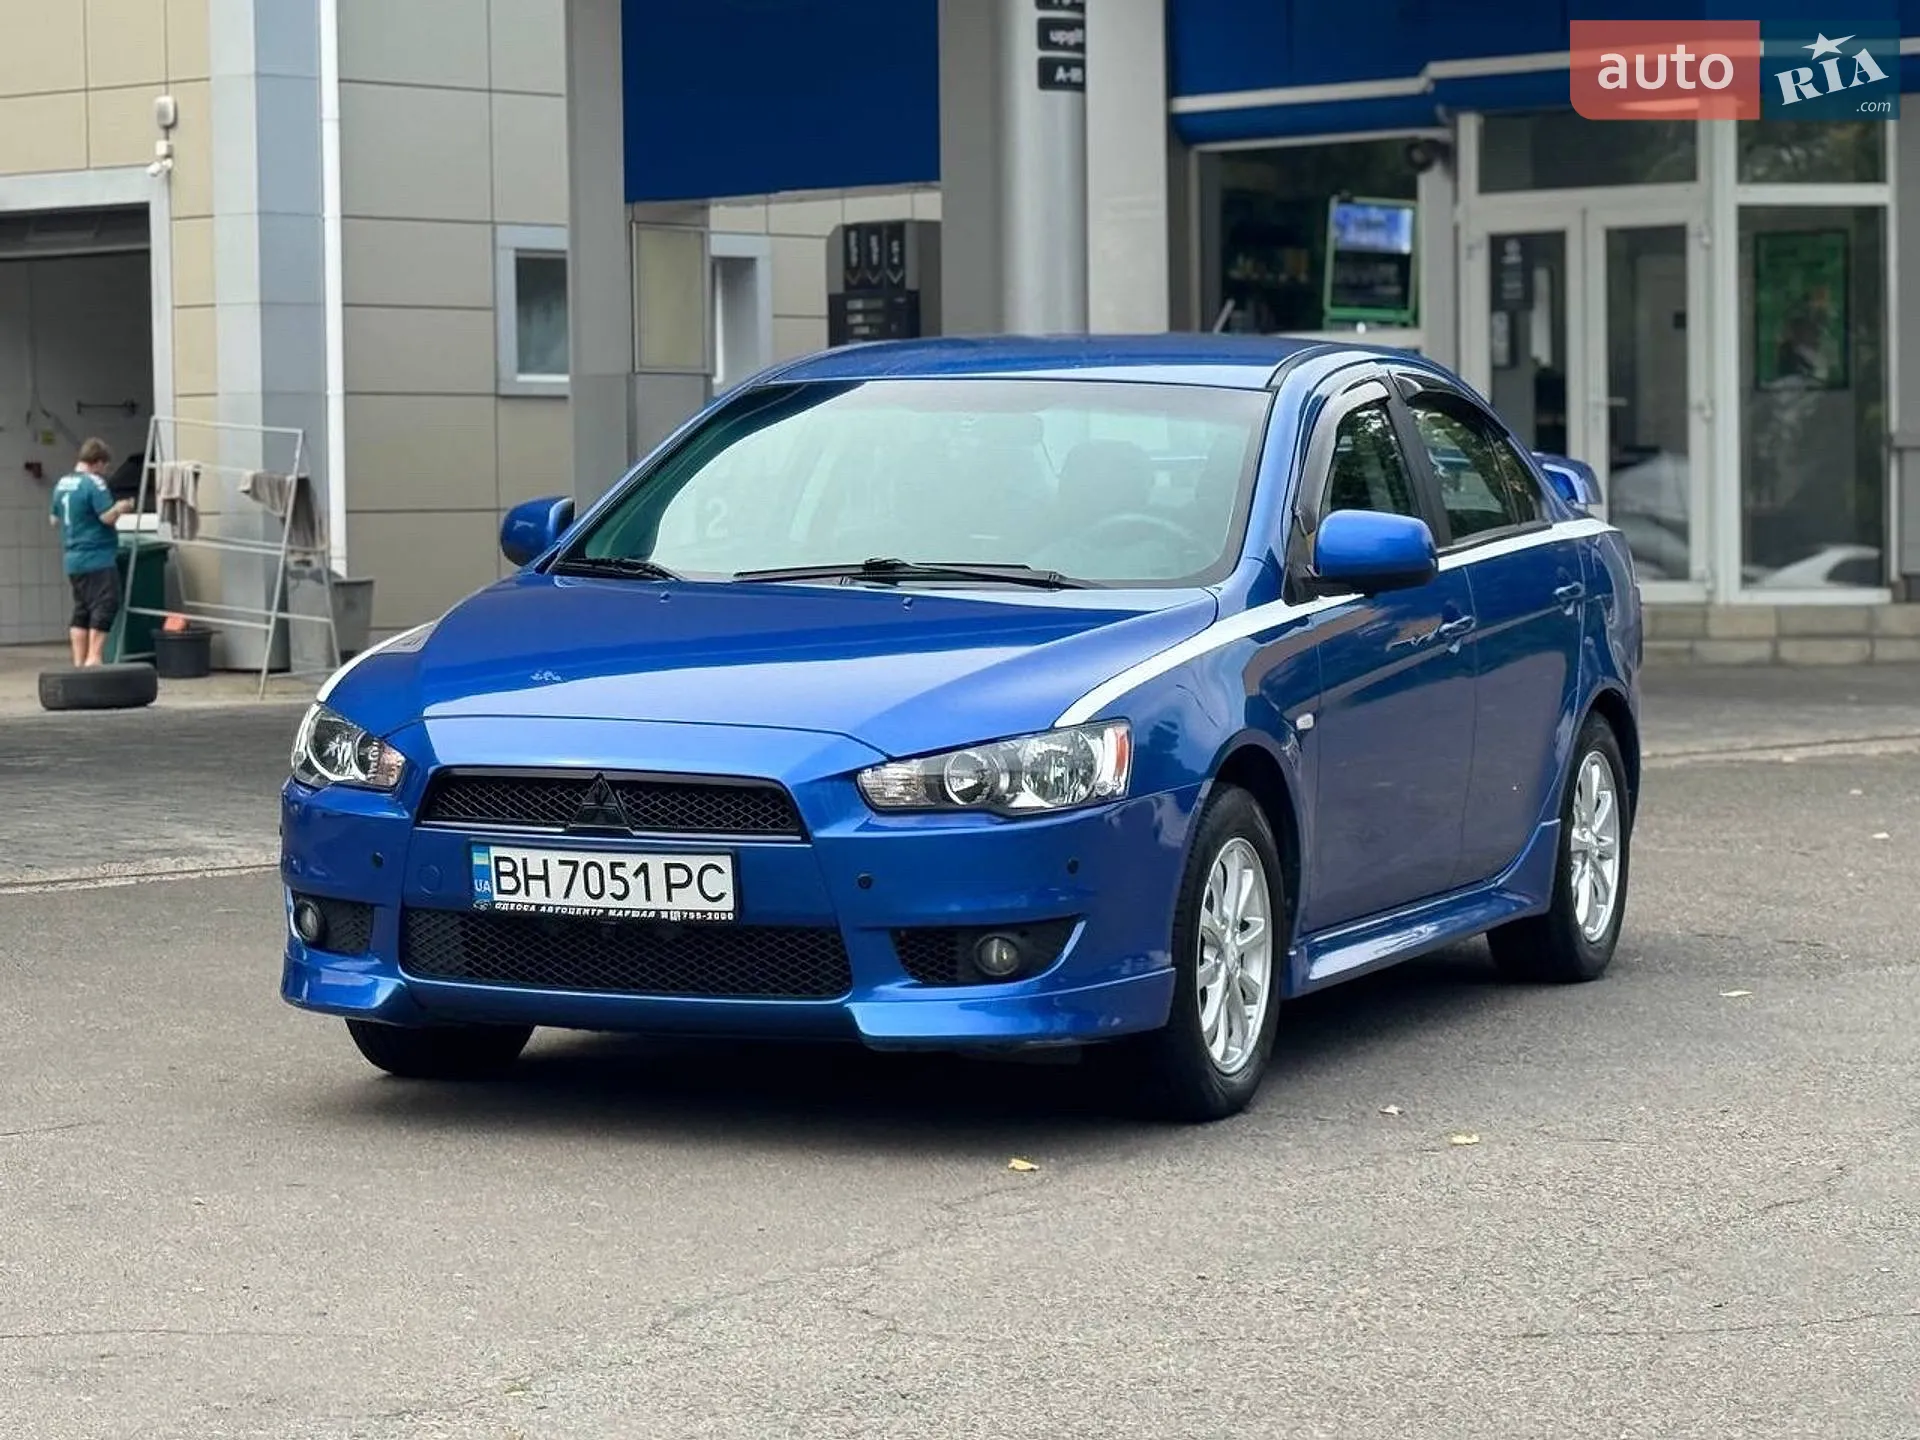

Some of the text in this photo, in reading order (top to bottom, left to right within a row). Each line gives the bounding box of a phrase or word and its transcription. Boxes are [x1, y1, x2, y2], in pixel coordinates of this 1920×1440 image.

[61, 492, 71, 526] 1
[474, 878, 492, 893] UA
[493, 855, 728, 903] BH 7051 PC
